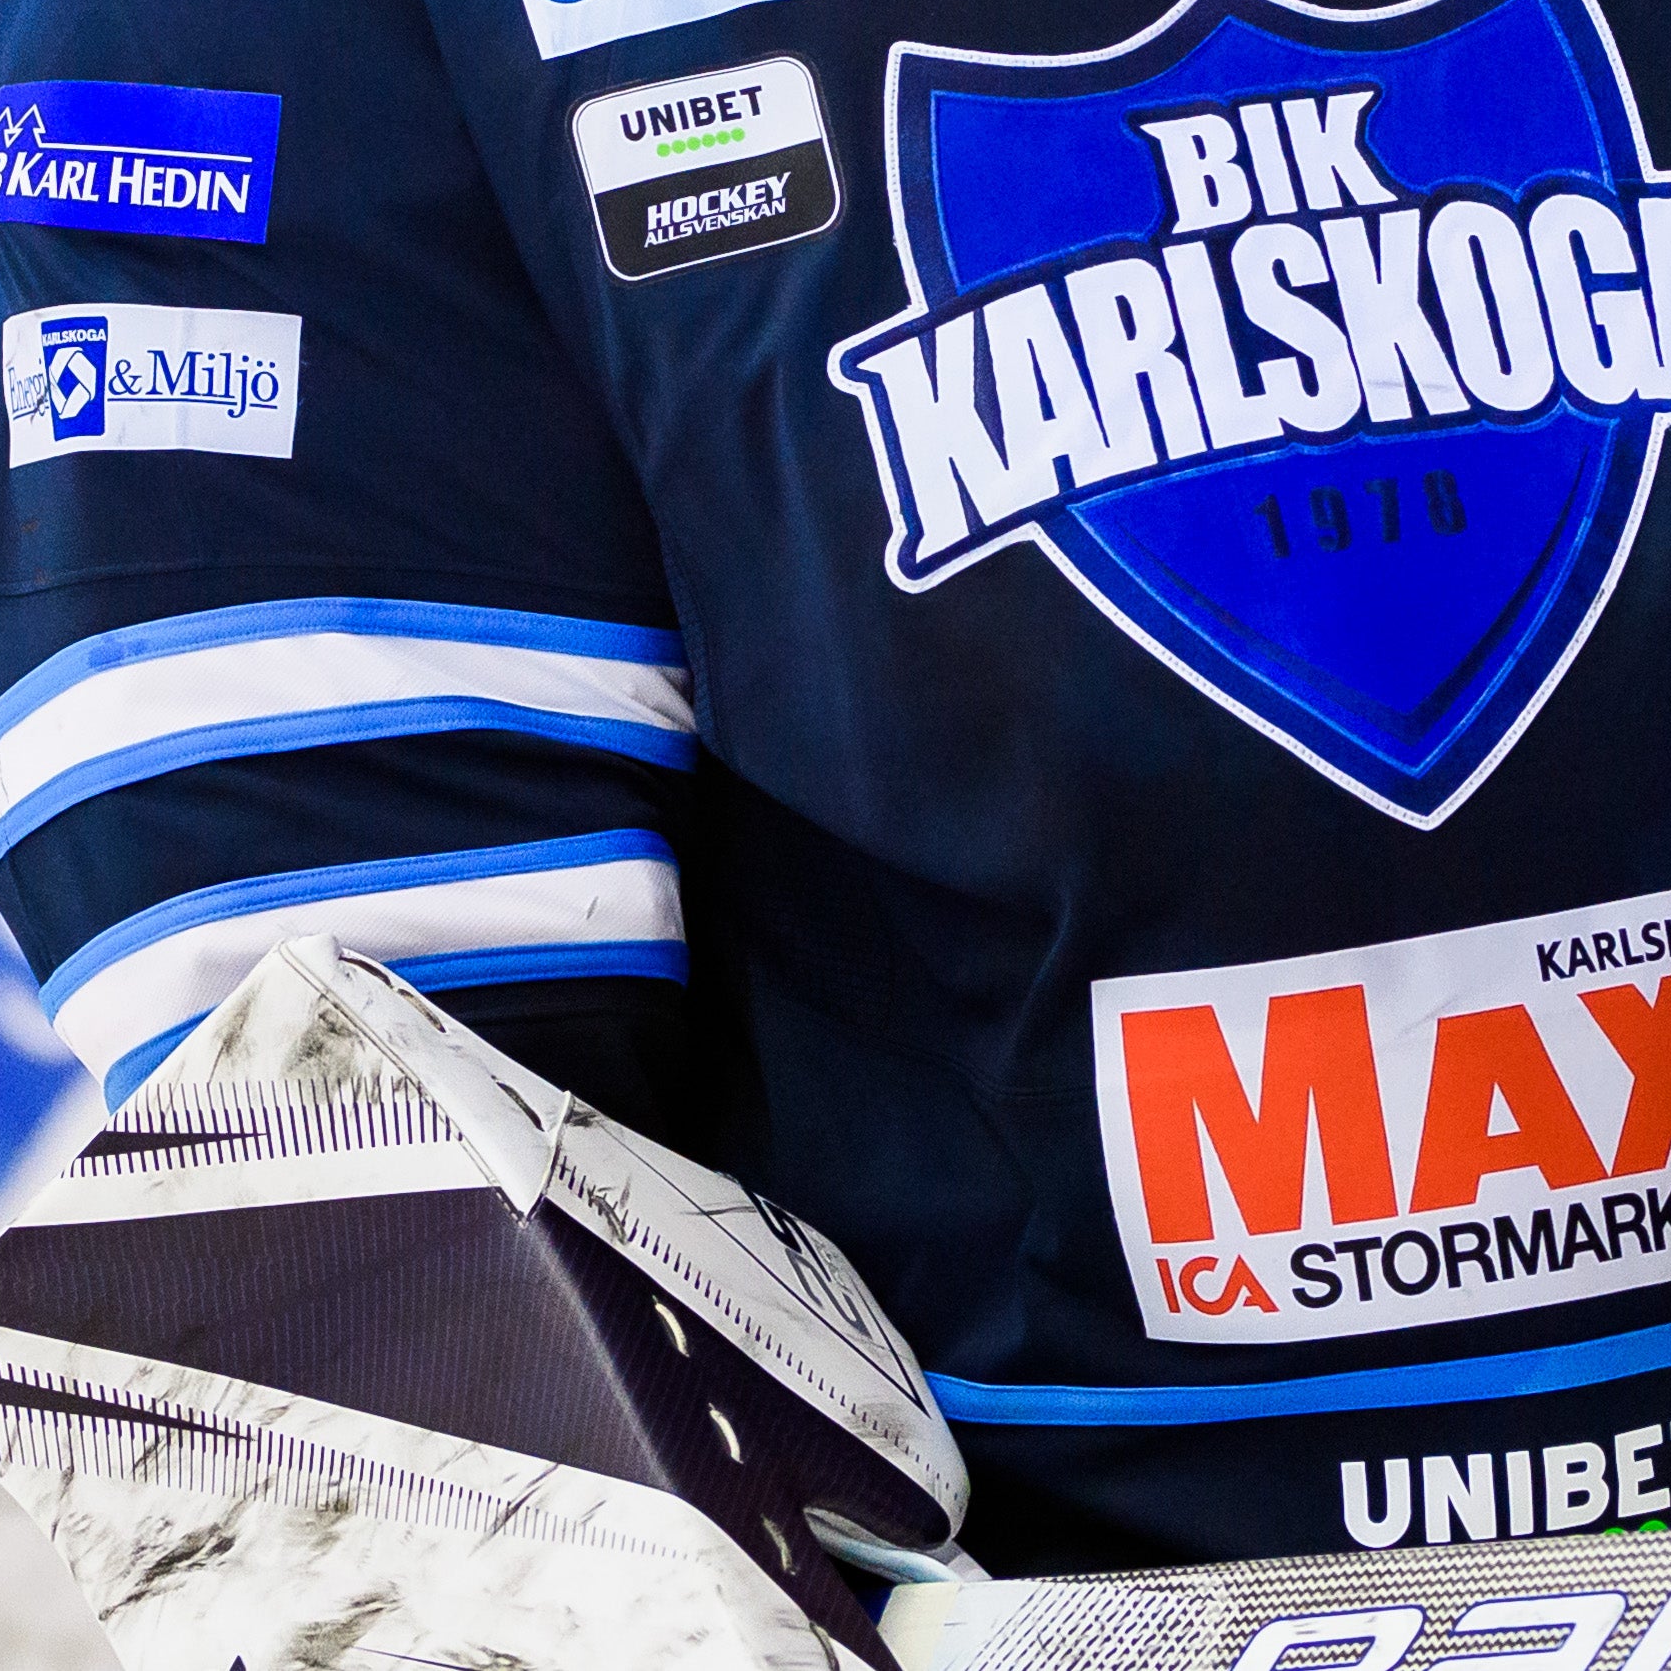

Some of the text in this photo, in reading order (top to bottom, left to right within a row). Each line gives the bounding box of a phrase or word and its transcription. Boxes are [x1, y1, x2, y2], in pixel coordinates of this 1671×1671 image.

[619, 84, 763, 142] UNIBET
[5, 151, 101, 203] KARL
[107, 156, 251, 214] HEDIN
[1138, 89, 1397, 235] BIK
[643, 197, 787, 249] ALLSVENSKAN
[646, 171, 792, 231] HOCKEY
[42, 328, 107, 347] KARLSKOGA
[145, 349, 280, 419] Miljö
[1155, 1253, 1280, 1317] ICA
